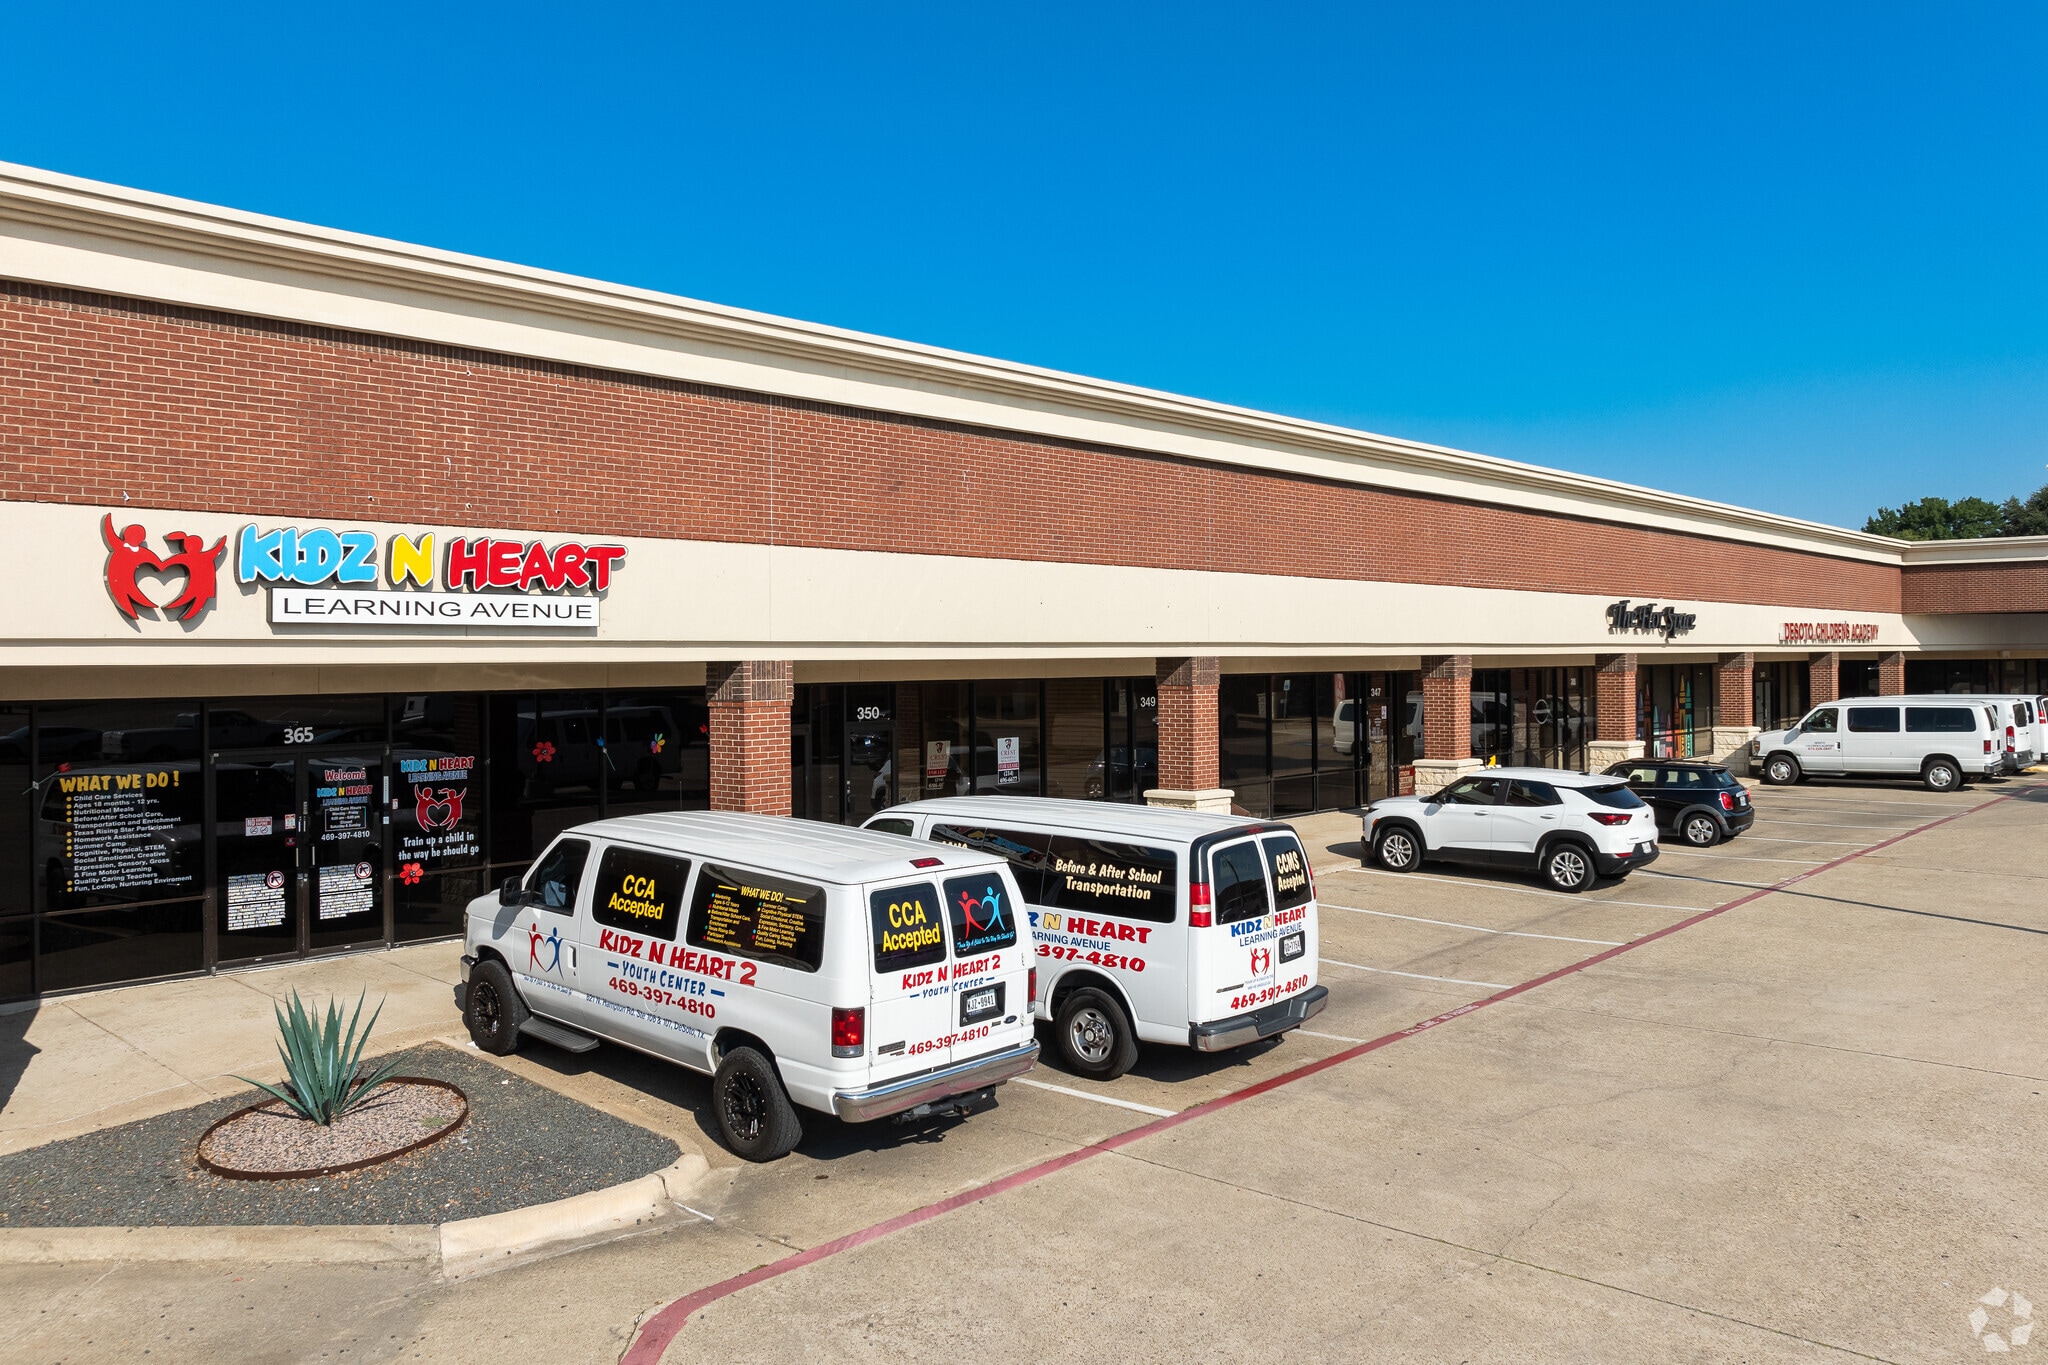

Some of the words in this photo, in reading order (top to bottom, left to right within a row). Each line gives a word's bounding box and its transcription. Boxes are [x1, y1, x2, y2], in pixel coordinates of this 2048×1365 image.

[239, 523, 379, 584] KIDZ
[390, 532, 435, 587] N
[447, 536, 628, 592] HEART
[282, 597, 462, 618] LEARNING
[470, 601, 593, 620] AVENUE
[1607, 600, 1638, 628] The
[1784, 623, 1814, 640] DESOTO
[1815, 621, 1850, 640] CHILDREN'S
[1851, 623, 1879, 640] ACADEMY
[1140, 696, 1156, 707] 349
[1370, 687, 1381, 697] 347
[856, 706, 880, 720] 350
[283, 726, 314, 744] 365
[324, 768, 366, 781] Welcome
[400, 759, 427, 772] KIDZ
[428, 758, 438, 771] N
[438, 756, 474, 771] HEART
[60, 775, 111, 792] WHAT
[116, 774, 141, 789] WE
[146, 772, 168, 787] DO
[338, 787, 345, 797] N
[345, 784, 373, 796] HEART
[74, 821, 126, 829] Transportation
[321, 830, 370, 841] 469-397-4810
[403, 836, 424, 847] Train
[426, 837, 436, 847] up
[445, 832, 464, 843] child
[466, 832, 475, 841] in
[398, 850, 412, 860] the
[413, 850, 429, 860] way
[431, 847, 441, 858] he
[443, 844, 468, 856] should
[470, 845, 480, 856] go
[1276, 850, 1300, 875] CCMS
[1055, 859, 1086, 874] Before
[1088, 863, 1096, 876] &
[1099, 864, 1126, 880] After
[1128, 868, 1162, 884] School
[1278, 869, 1306, 892] Accepted
[622, 874, 655, 899] CCA
[741, 885, 760, 898] WHAT
[760, 889, 771, 900] WE
[1065, 876, 1151, 900] Transportation
[608, 892, 665, 920] Accepted
[888, 900, 927, 928] CCA
[1043, 912, 1061, 930] N
[1067, 917, 1152, 944] HEART
[1230, 918, 1262, 937] KIDZ
[1263, 915, 1273, 930] N
[1274, 906, 1306, 926] HEART
[882, 922, 941, 952] Accepted
[1070, 937, 1111, 952] AVENUE
[1239, 929, 1278, 947] LEARNING
[1278, 921, 1302, 937] AVENUE
[599, 928, 644, 958] KIDZ
[648, 942, 666, 964] N
[670, 946, 736, 980] HEART
[739, 961, 758, 987] 2
[622, 960, 656, 984] YOUTH
[660, 970, 706, 997] CENTER
[902, 971, 933, 990] KIDZ
[938, 966, 948, 982] N
[953, 958, 990, 980] HEART
[992, 954, 1000, 970] 2
[608, 976, 716, 1019] 469-397-4810
[922, 985, 949, 998] YOUTH
[952, 977, 984, 992] CENTER
[1230, 974, 1308, 1010] 469-397-4810
[602, 998, 626, 1012] Hampton
[908, 1025, 989, 1056] 469-397-4810
